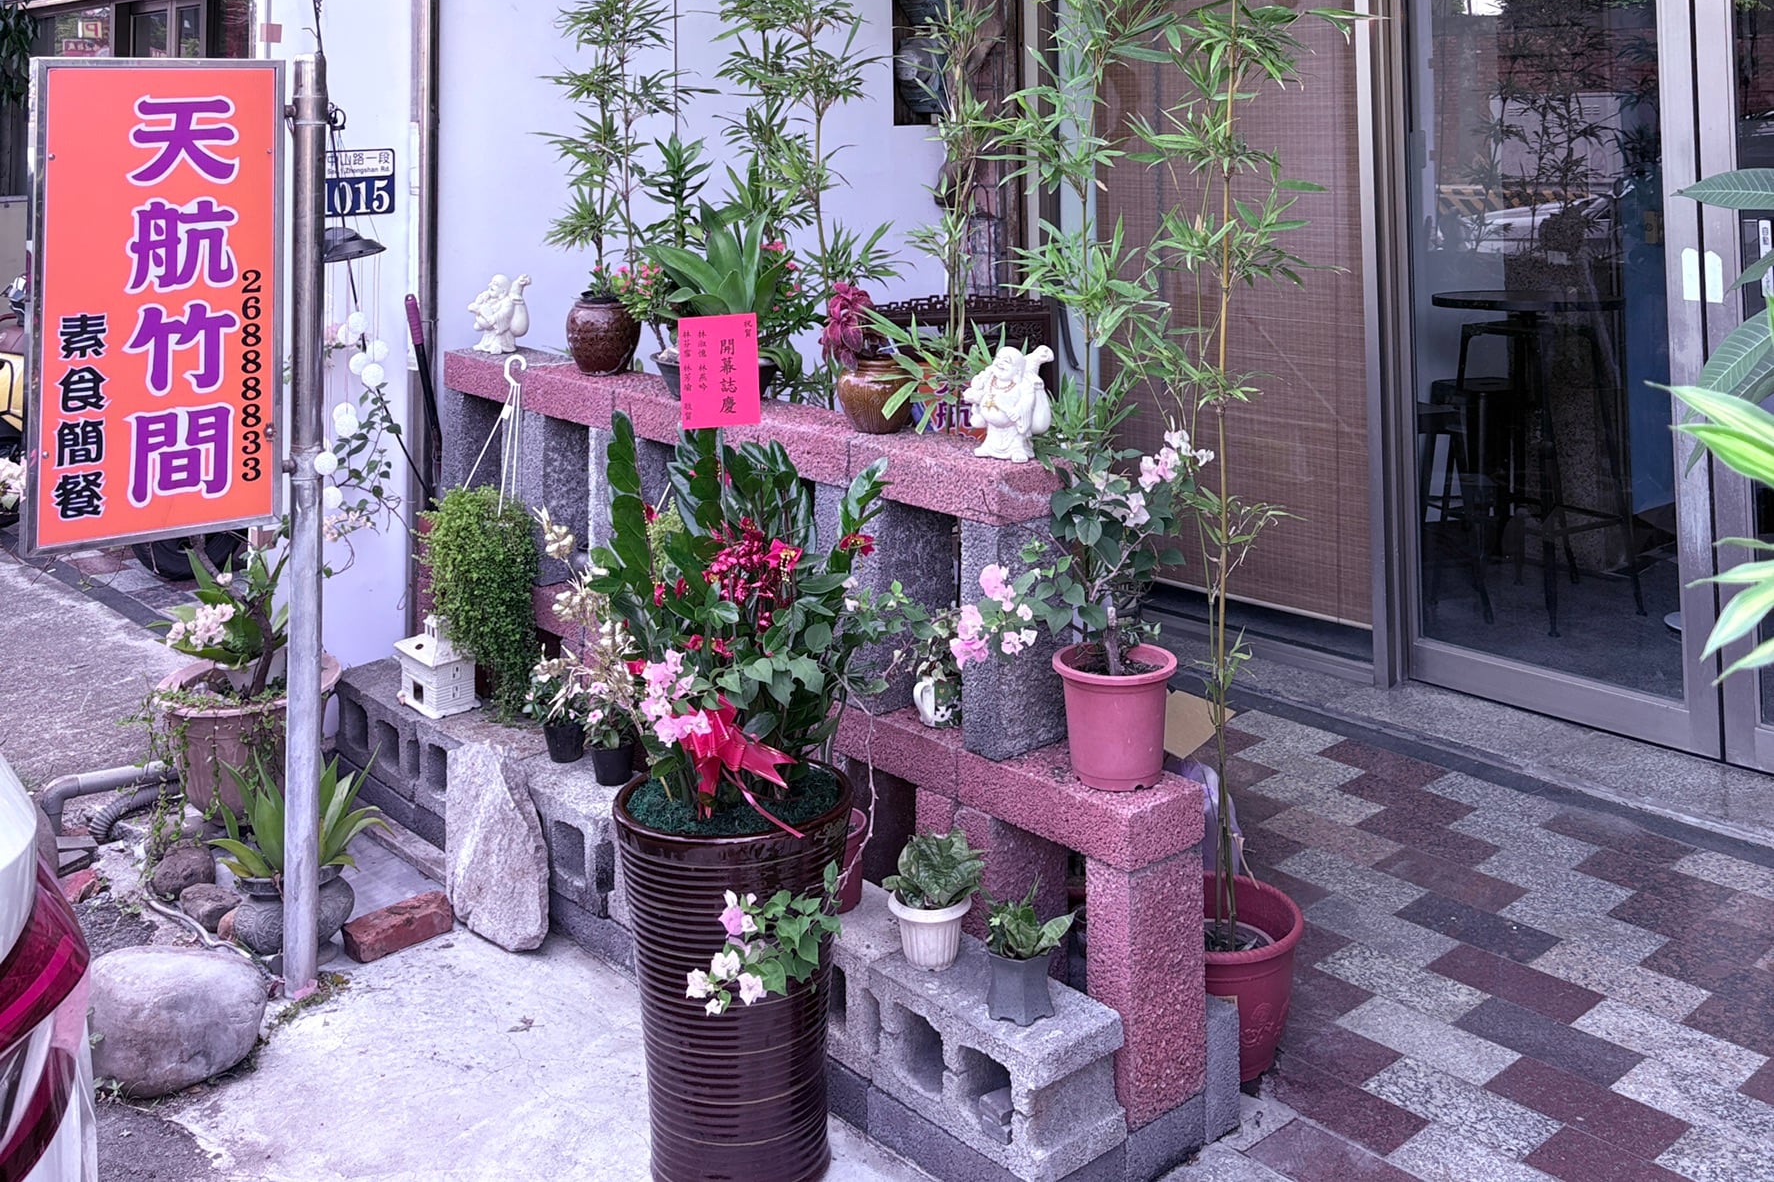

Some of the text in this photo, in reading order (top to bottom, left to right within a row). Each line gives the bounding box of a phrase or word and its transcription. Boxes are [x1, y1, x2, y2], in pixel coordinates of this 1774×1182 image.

[125, 96, 239, 507] 天航竹間
[241, 269, 262, 482] 26888833
[720, 339, 737, 413] 開幕誌慶
[55, 313, 108, 519] 素食簡餐
